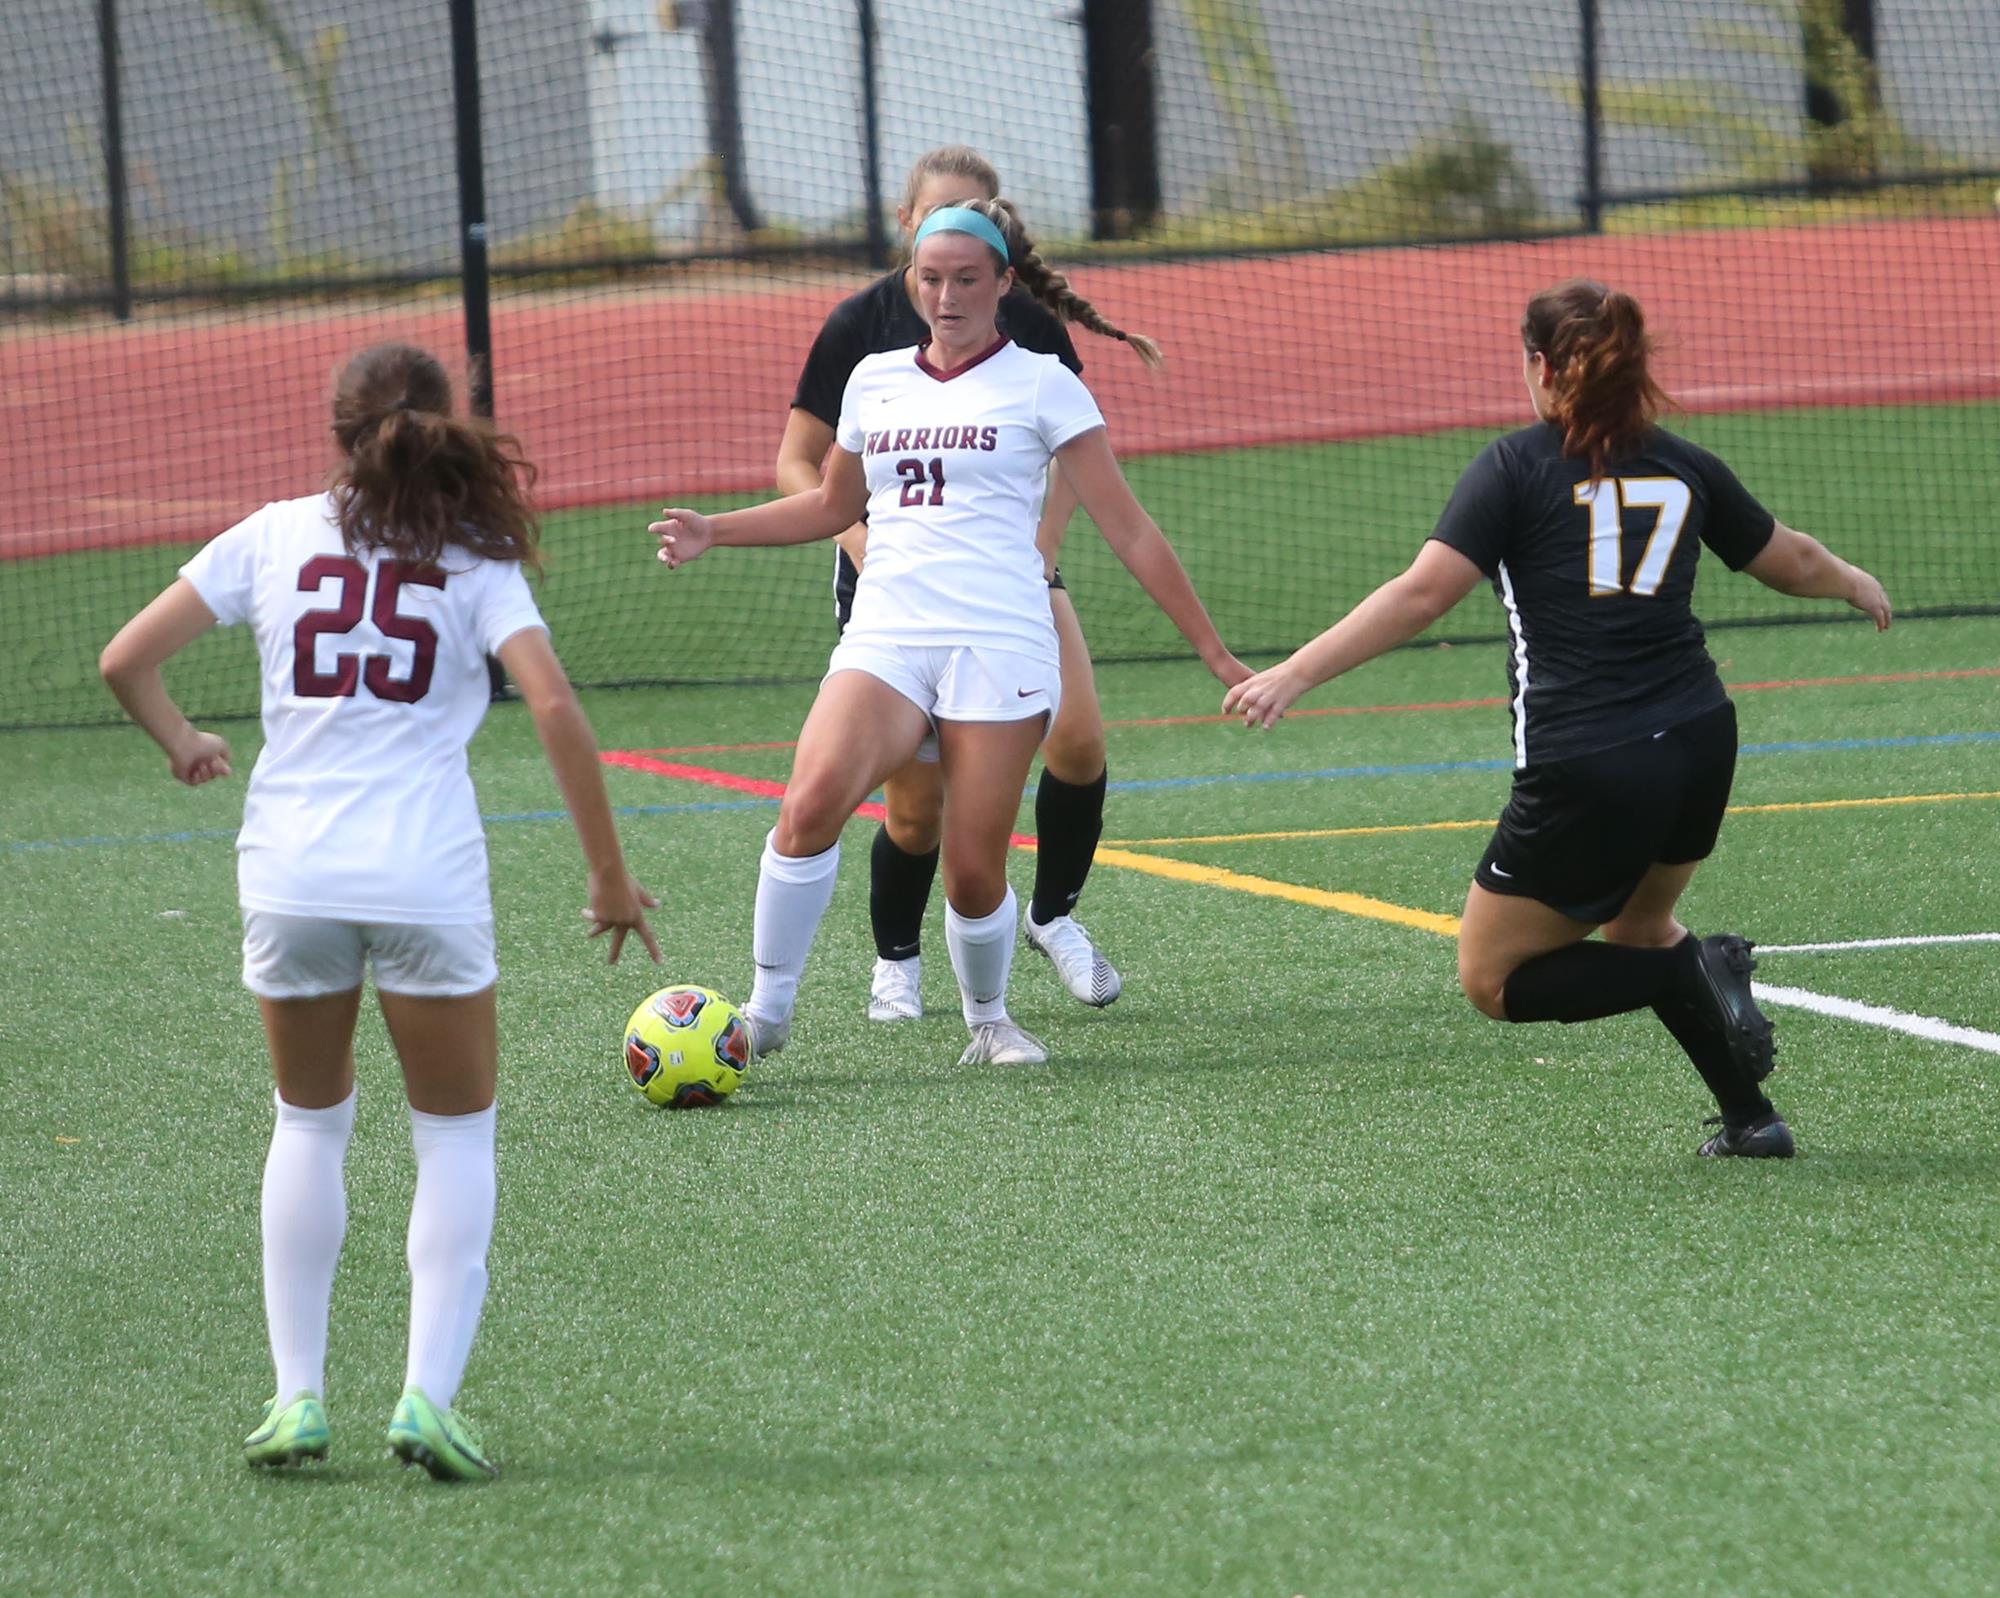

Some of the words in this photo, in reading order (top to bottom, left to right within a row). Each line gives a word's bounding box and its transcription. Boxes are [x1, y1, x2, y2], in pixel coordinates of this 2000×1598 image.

[866, 426, 998, 457] WARRIORS
[896, 457, 945, 507] 21
[1573, 476, 1692, 597] 17
[294, 553, 447, 704] 25
